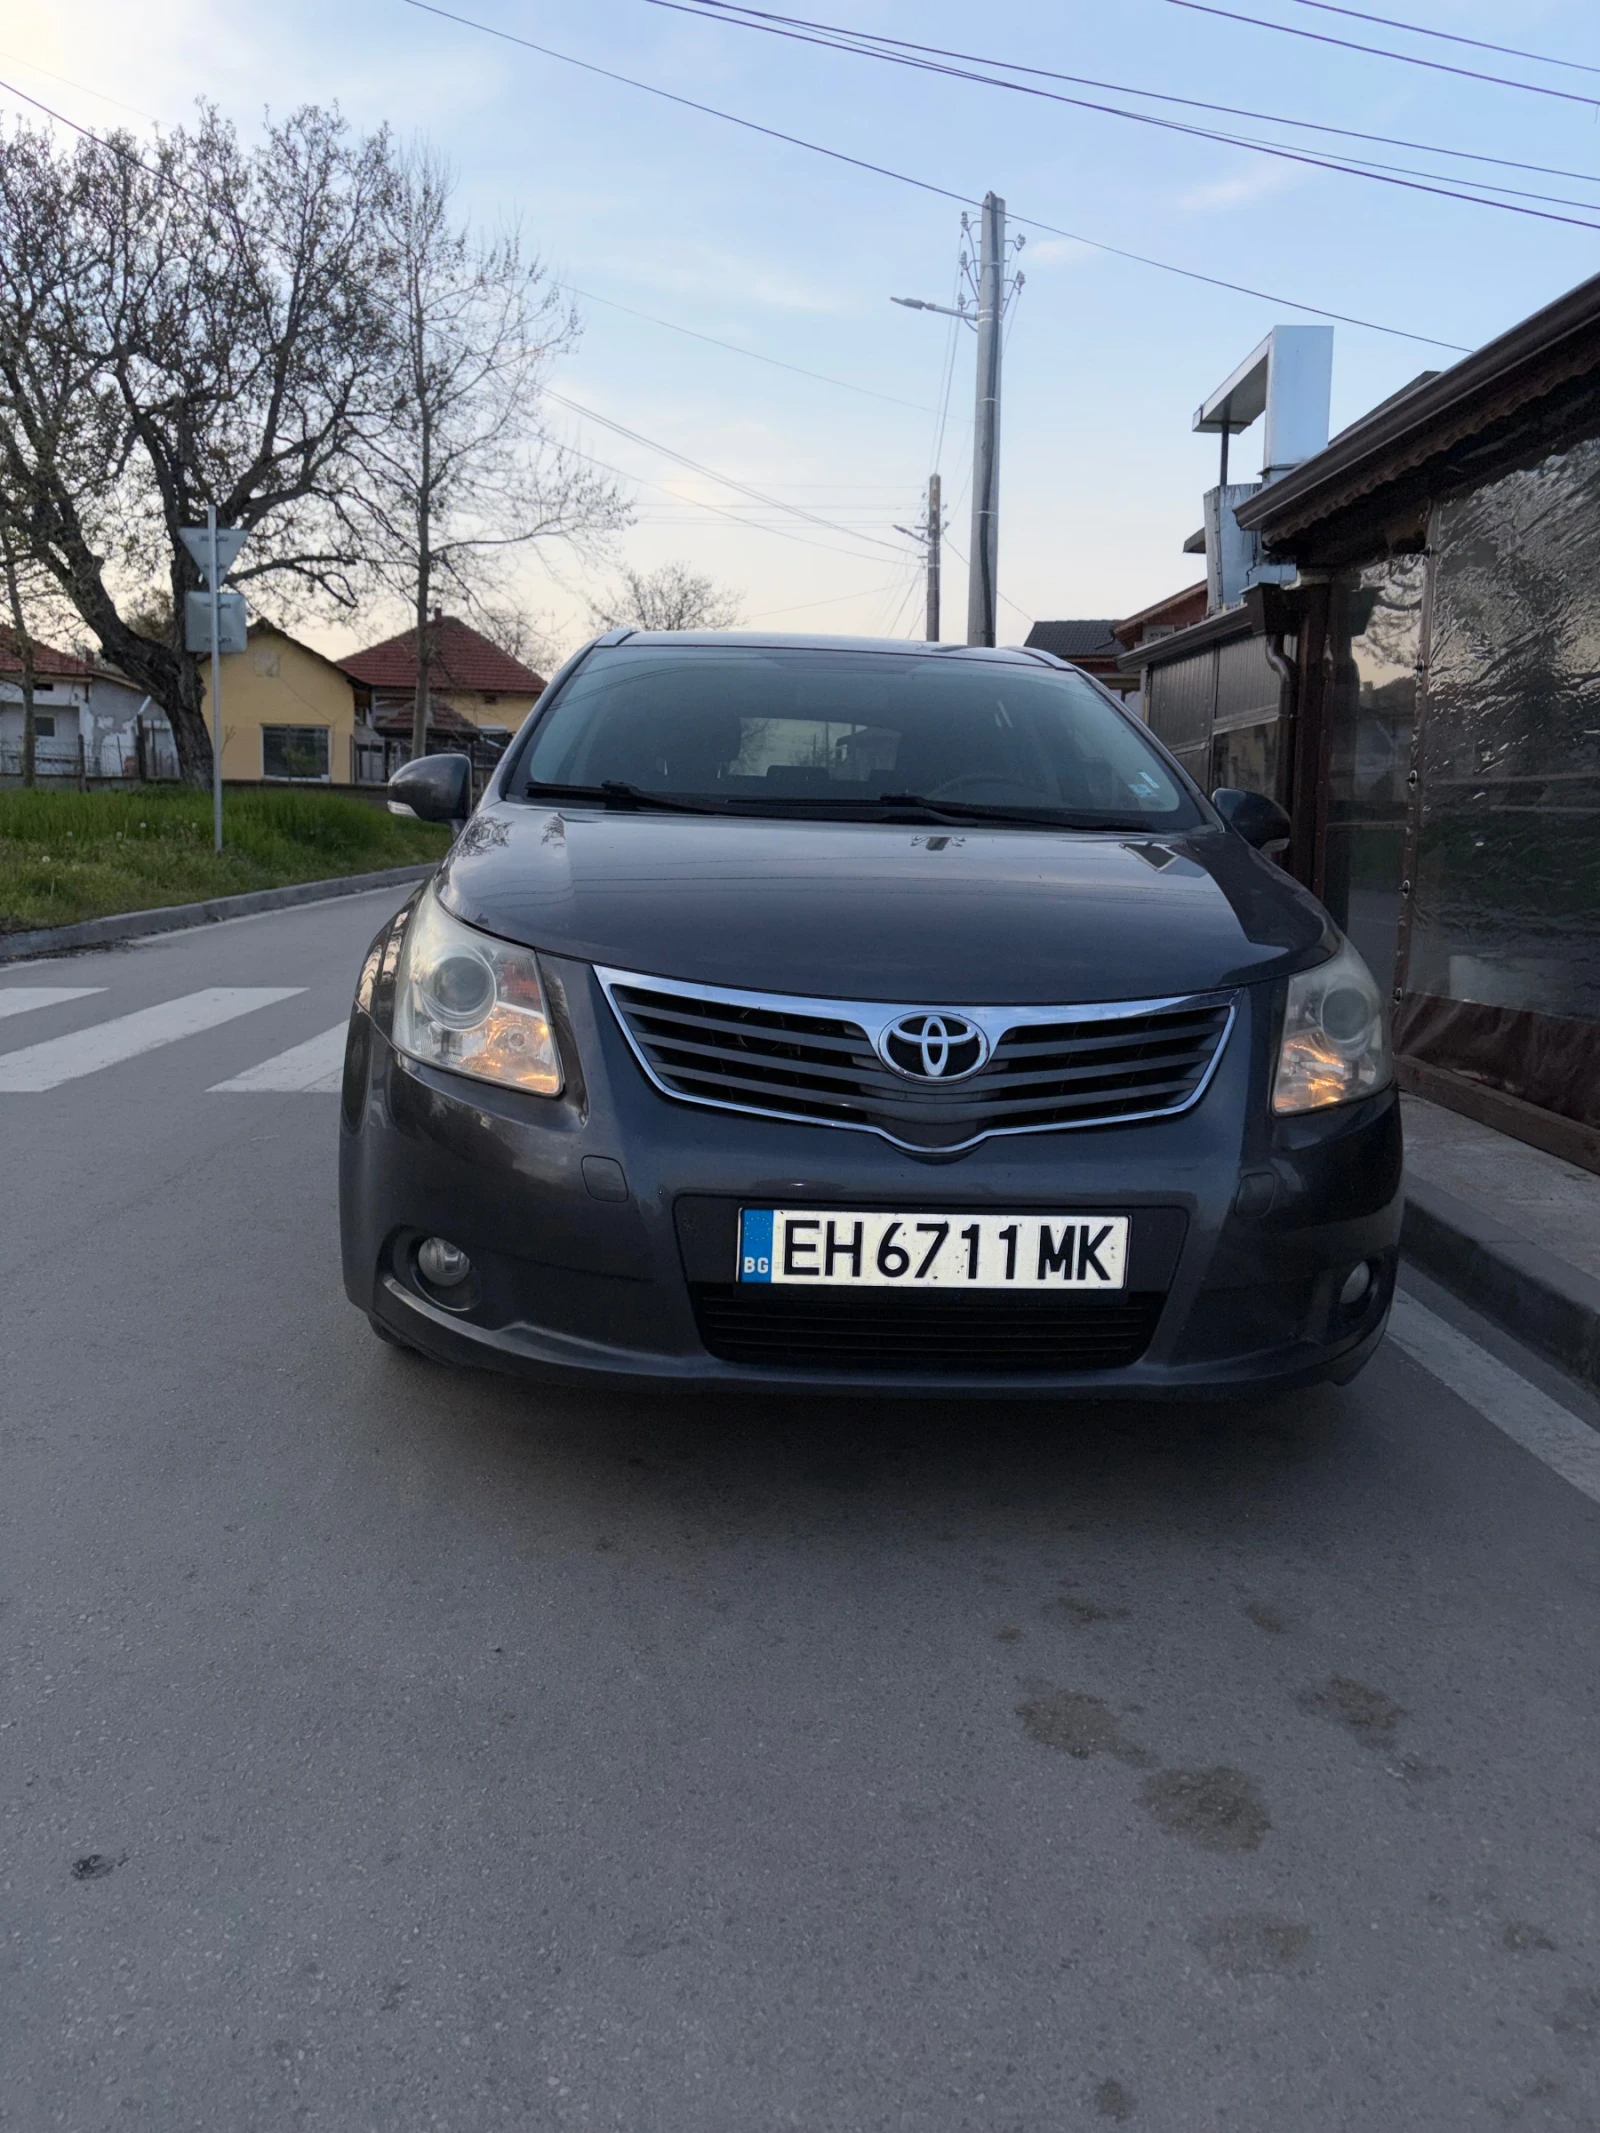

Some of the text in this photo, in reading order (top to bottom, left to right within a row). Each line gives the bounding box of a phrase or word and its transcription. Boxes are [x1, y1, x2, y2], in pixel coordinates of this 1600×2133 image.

[743, 1256, 769, 1274] BG
[783, 1219, 1114, 1281] EH 6711 MK
